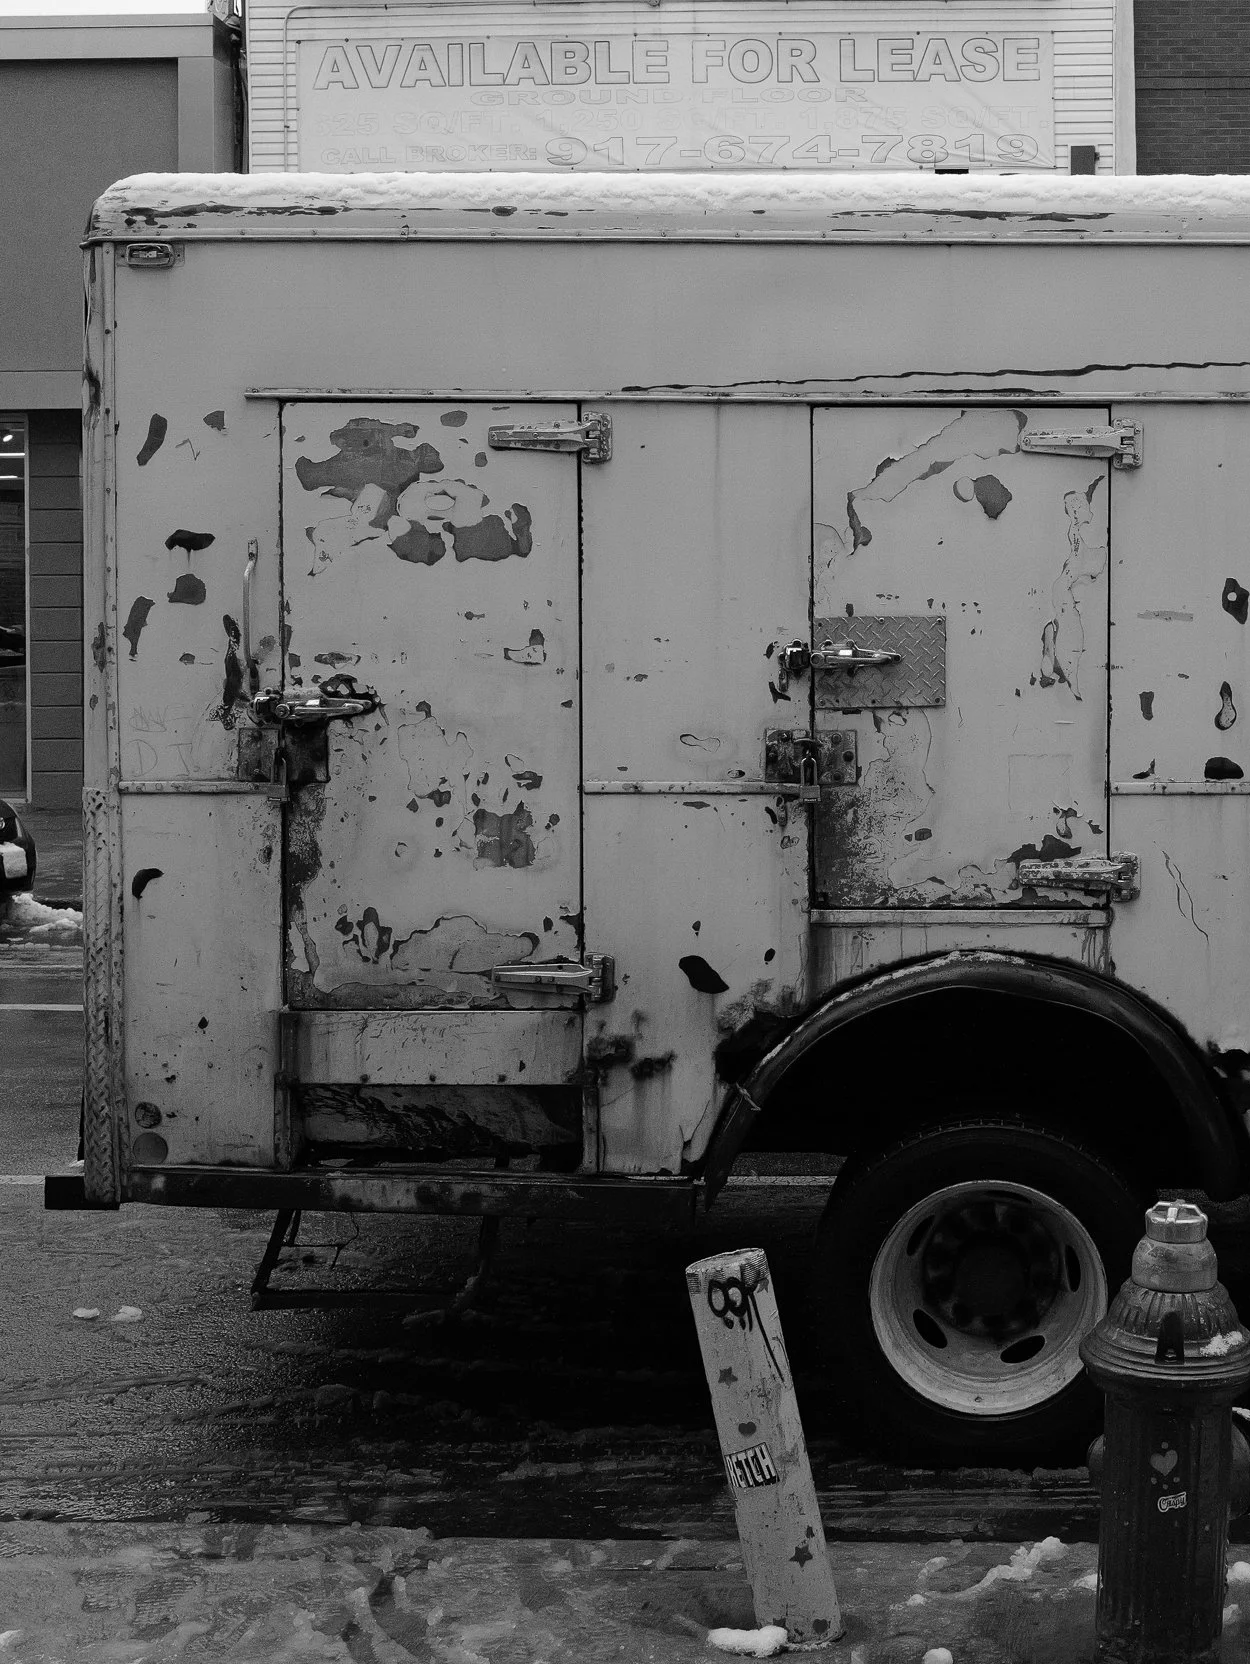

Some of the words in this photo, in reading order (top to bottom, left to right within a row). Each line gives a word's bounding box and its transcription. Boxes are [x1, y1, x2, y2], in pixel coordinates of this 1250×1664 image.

[312, 41, 671, 89] AVAILABLE
[692, 38, 820, 84] FOR
[840, 37, 1041, 83] LEASE
[470, 89, 684, 106] GROUND
[701, 87, 867, 104] FLOOR
[320, 147, 397, 165] CALL
[405, 143, 537, 162] BROKER:
[544, 133, 1039, 166] 917-674-7819
[726, 1444, 776, 1488] RETCH
